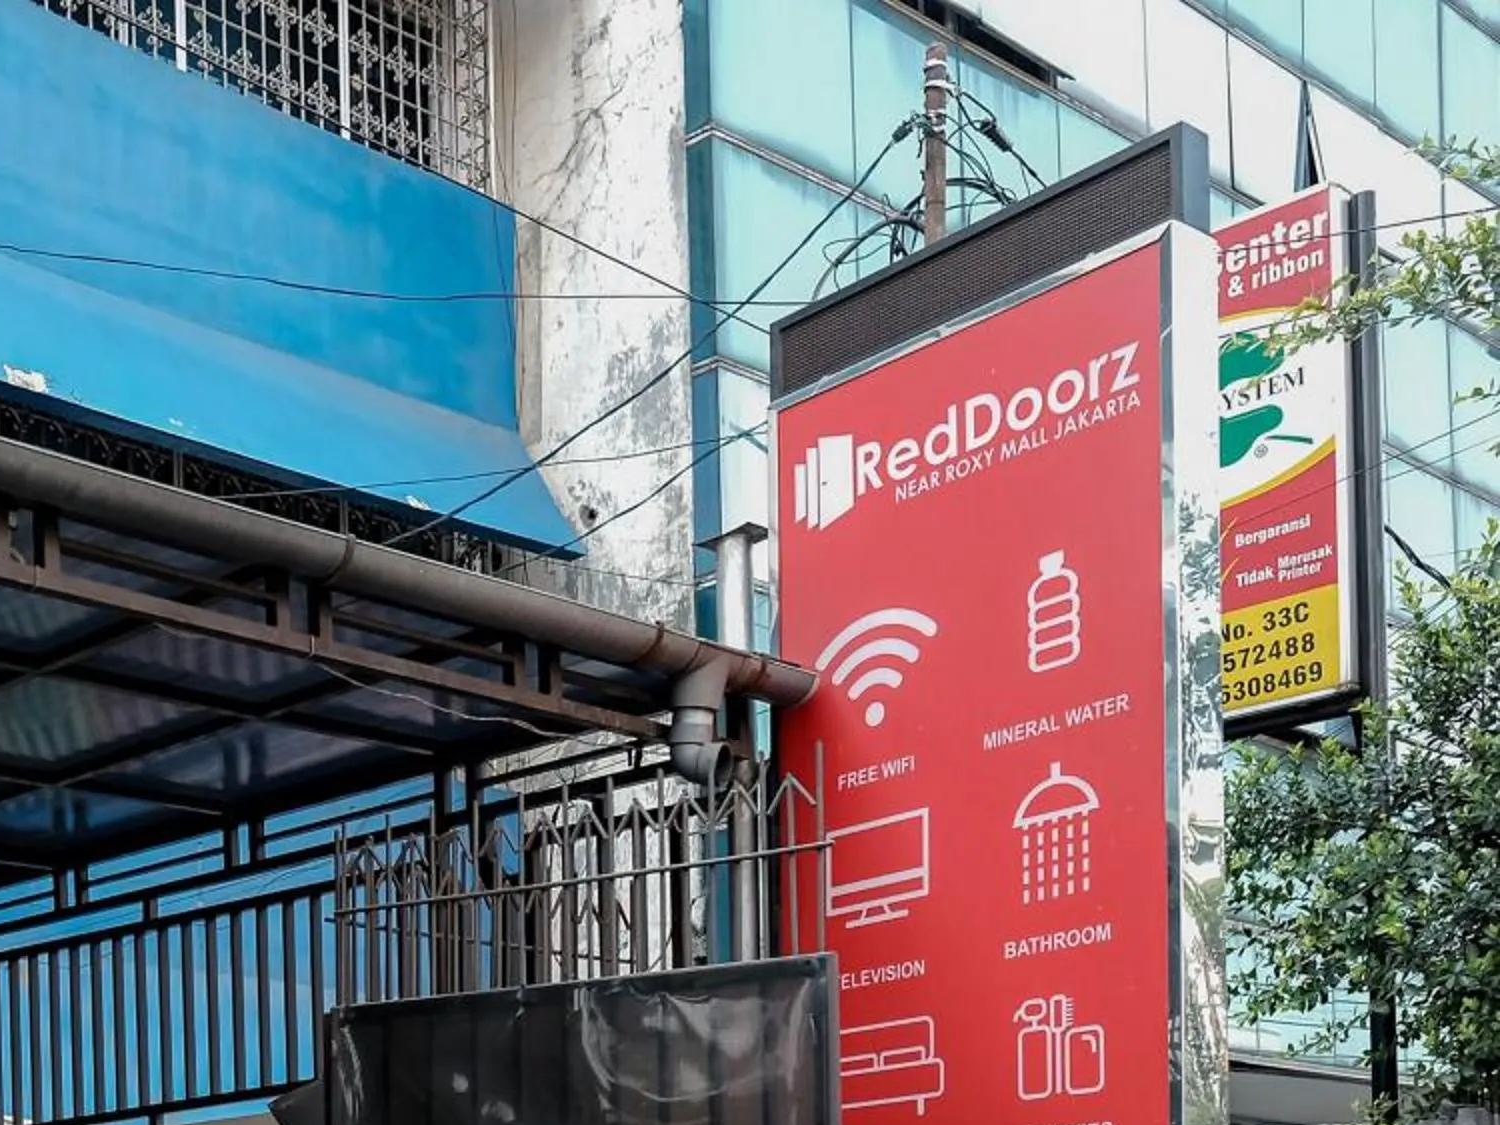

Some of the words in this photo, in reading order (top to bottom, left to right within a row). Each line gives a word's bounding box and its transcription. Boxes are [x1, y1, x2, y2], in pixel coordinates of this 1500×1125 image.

[1217, 211, 1328, 273] enter
[1227, 275, 1244, 298] &
[1251, 249, 1324, 289] ribbon
[1221, 367, 1304, 410] YSTEM
[857, 341, 1141, 496] RedDoorz
[895, 470, 940, 503] NEAR
[945, 448, 994, 482] ROXY
[1000, 432, 1048, 462] MALL
[1054, 391, 1141, 440] JAKARTA
[1236, 565, 1274, 587] Tidak
[1221, 624, 1253, 642] No.
[1263, 602, 1309, 632] 33C
[1223, 632, 1315, 673] 572488
[983, 713, 1060, 750] MINERAL
[1065, 693, 1130, 727] WATER
[837, 767, 877, 791] FREE
[881, 755, 915, 778] WIFI
[1004, 922, 1111, 960] BATHROOM
[838, 959, 925, 990] ELEVISION
